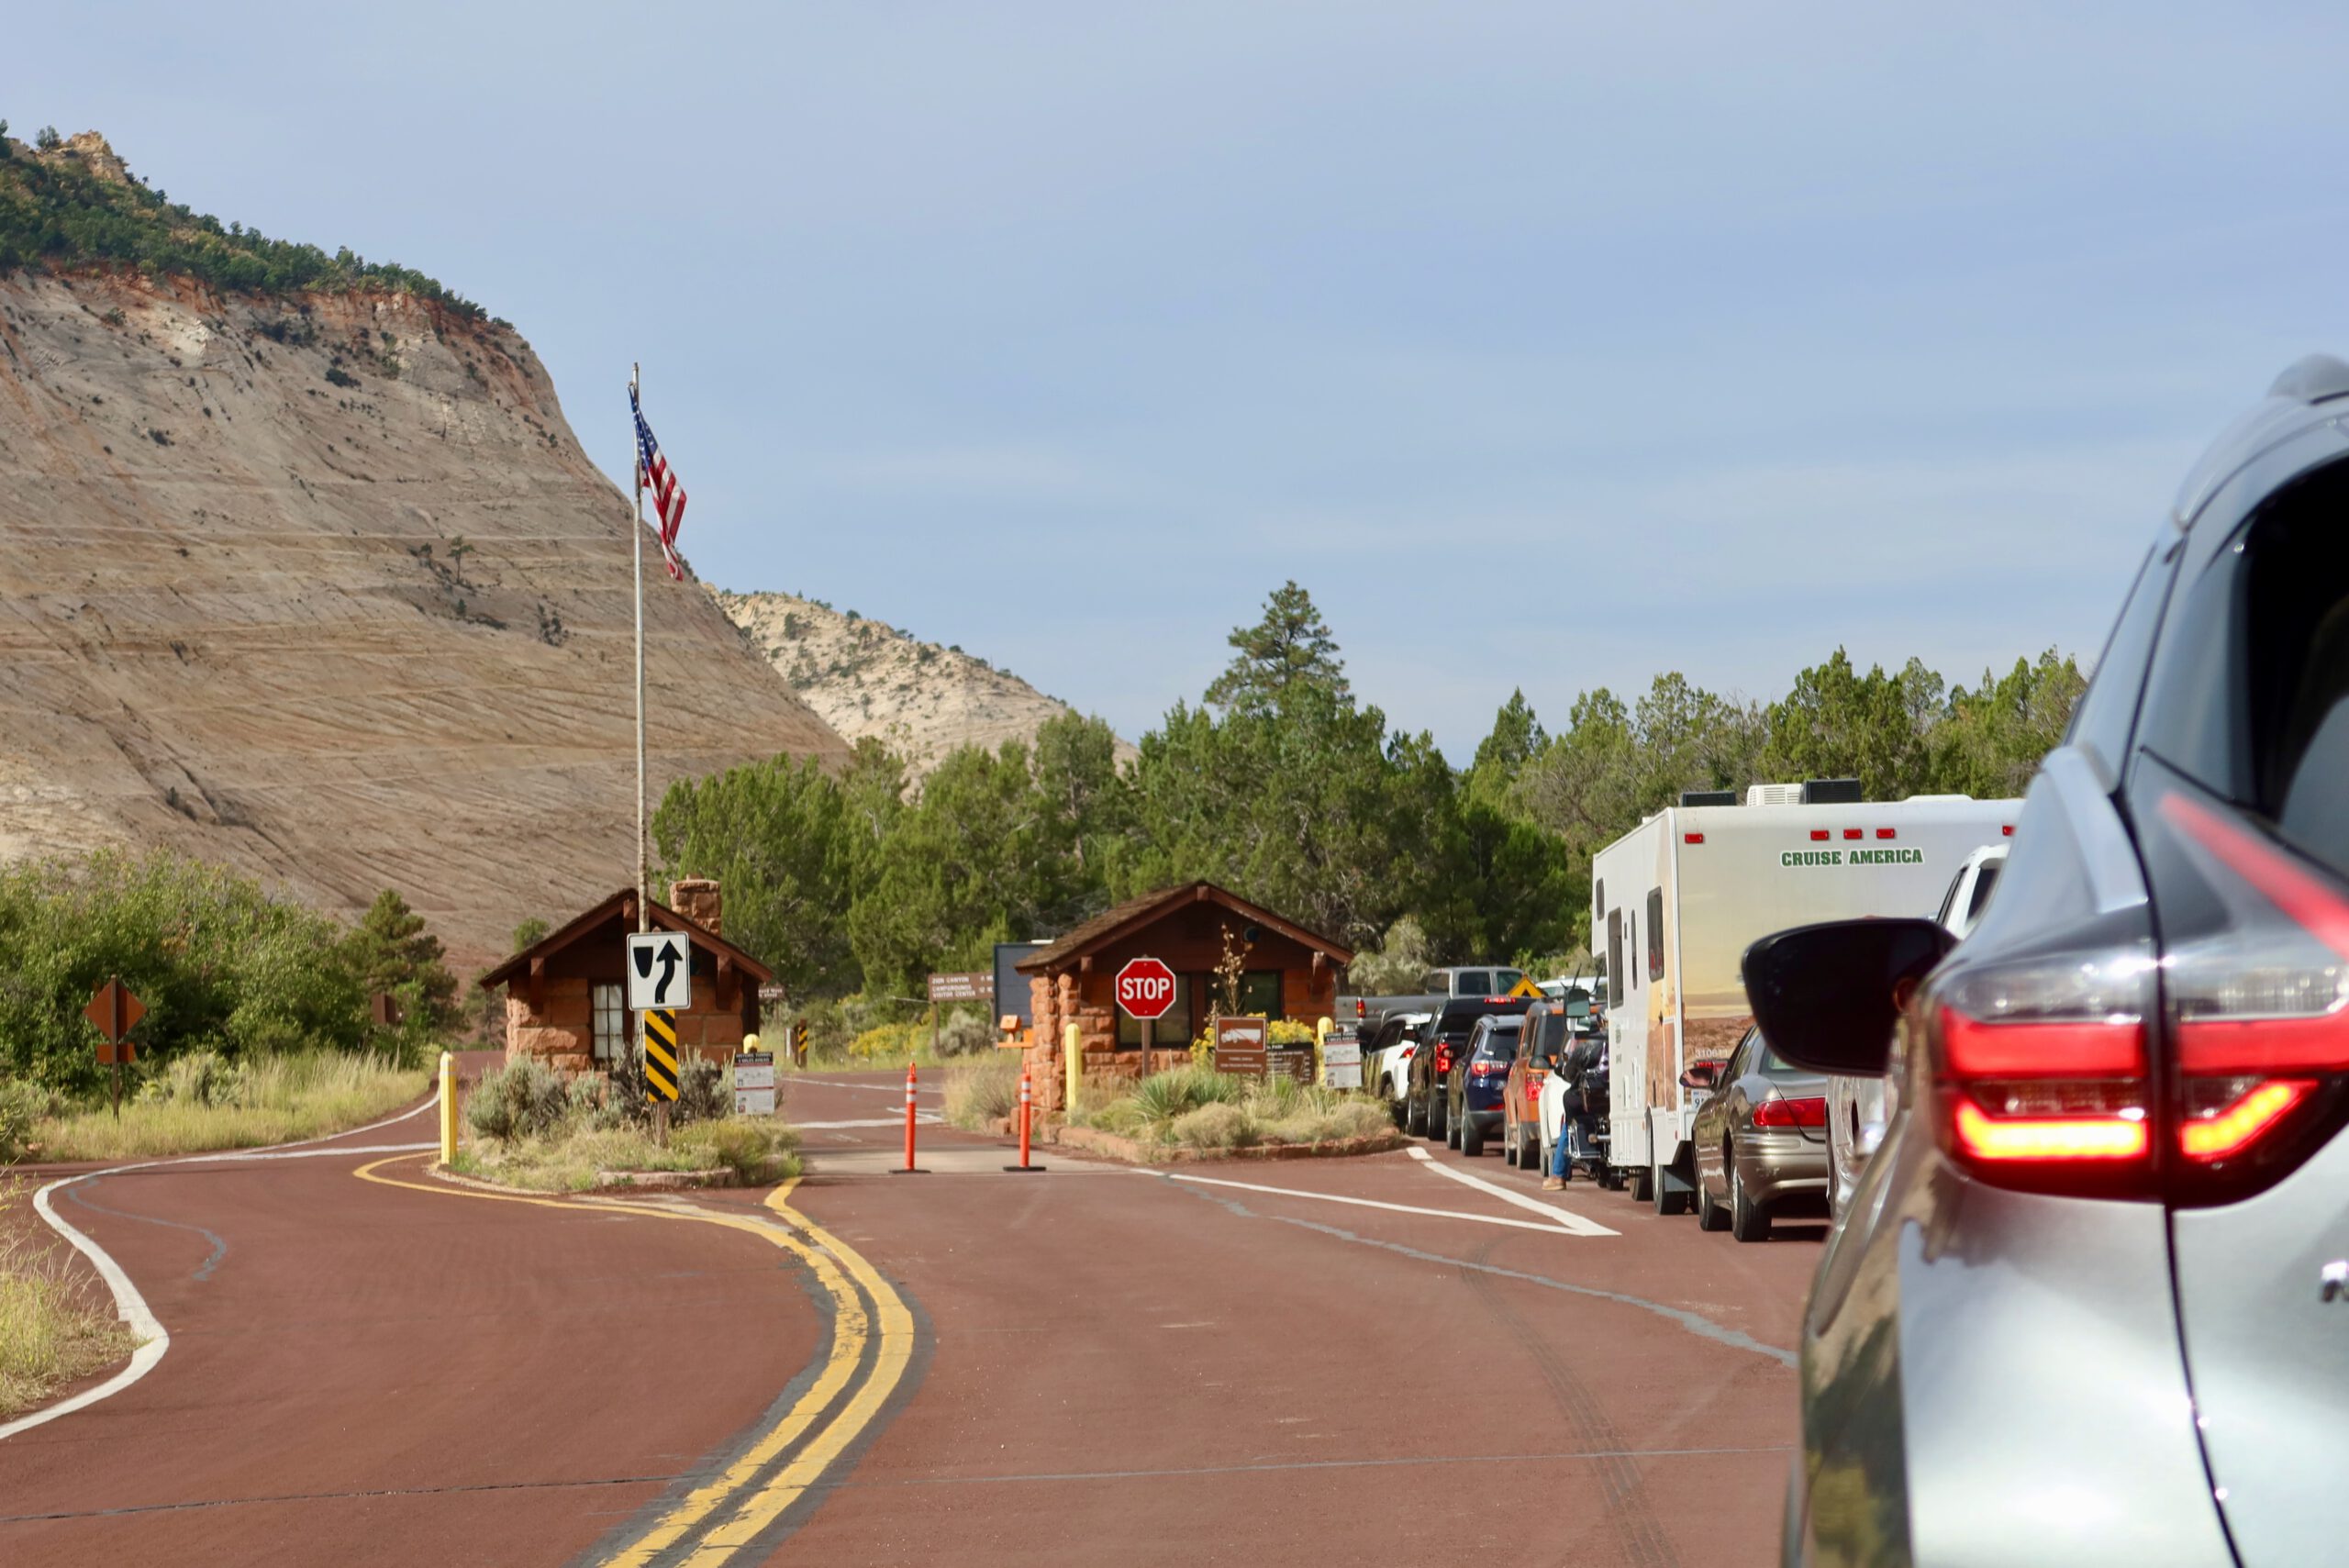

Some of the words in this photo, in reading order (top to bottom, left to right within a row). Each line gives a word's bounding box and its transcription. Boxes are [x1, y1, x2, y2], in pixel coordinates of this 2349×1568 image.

[1781, 851, 1842, 867] CRUISE
[1848, 849, 1923, 865] AMERICA
[1122, 977, 1171, 1000] STOP
